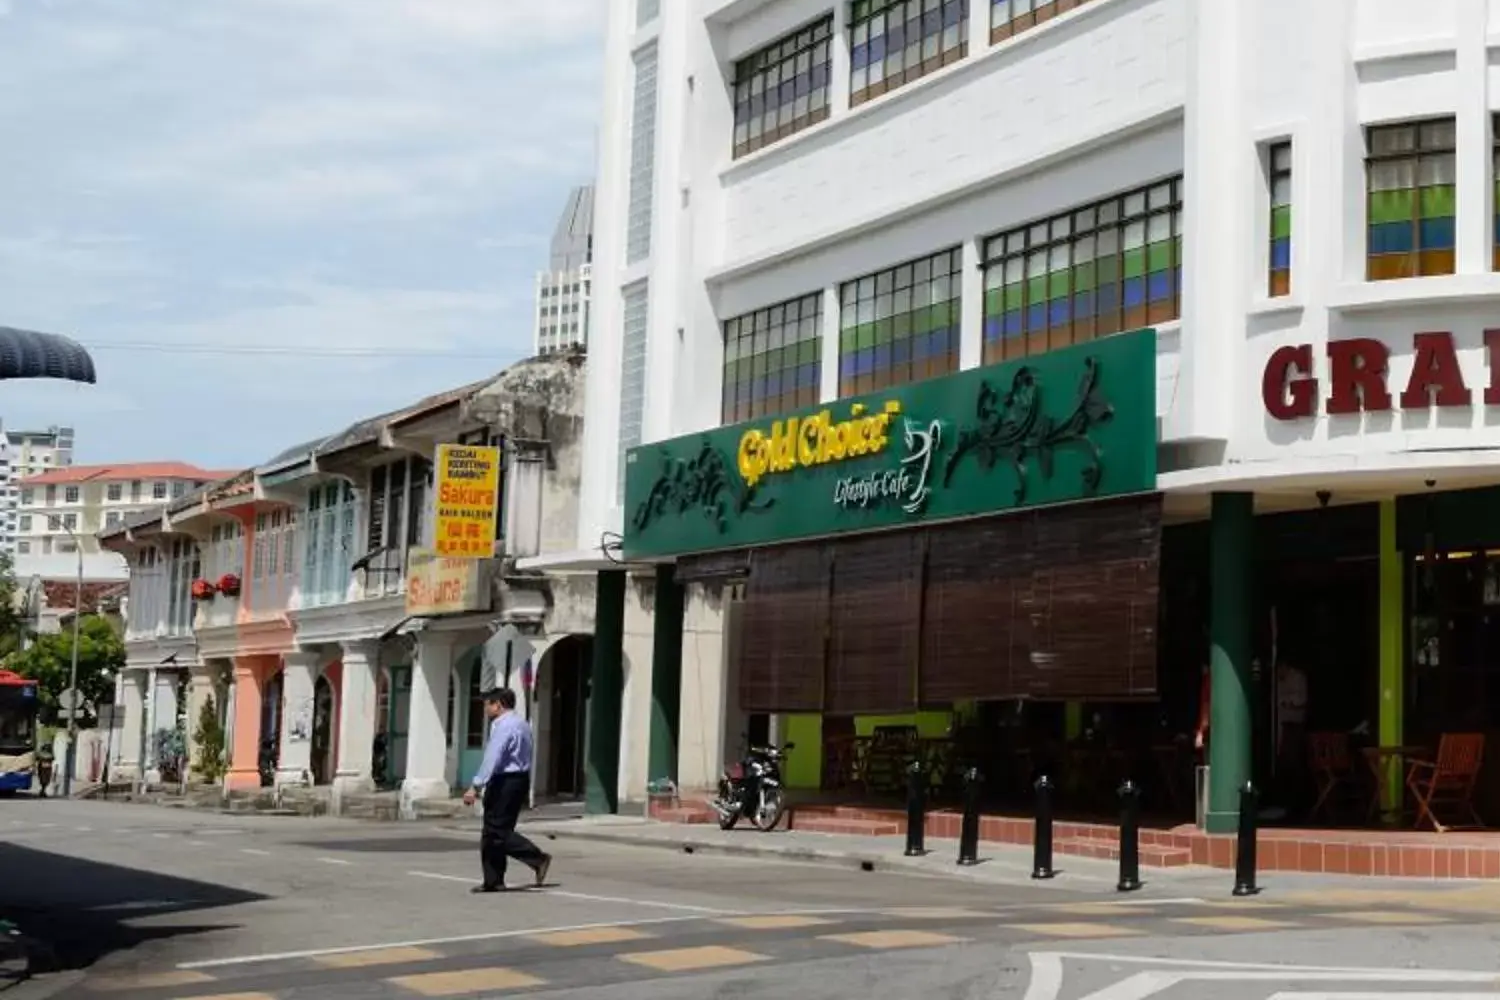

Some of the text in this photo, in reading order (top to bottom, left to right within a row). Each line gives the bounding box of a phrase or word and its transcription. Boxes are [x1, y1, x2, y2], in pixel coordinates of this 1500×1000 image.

[737, 404, 889, 487] Gold Choice
[439, 482, 495, 505] Sakura
[833, 468, 909, 508] Lifestyle Cafe
